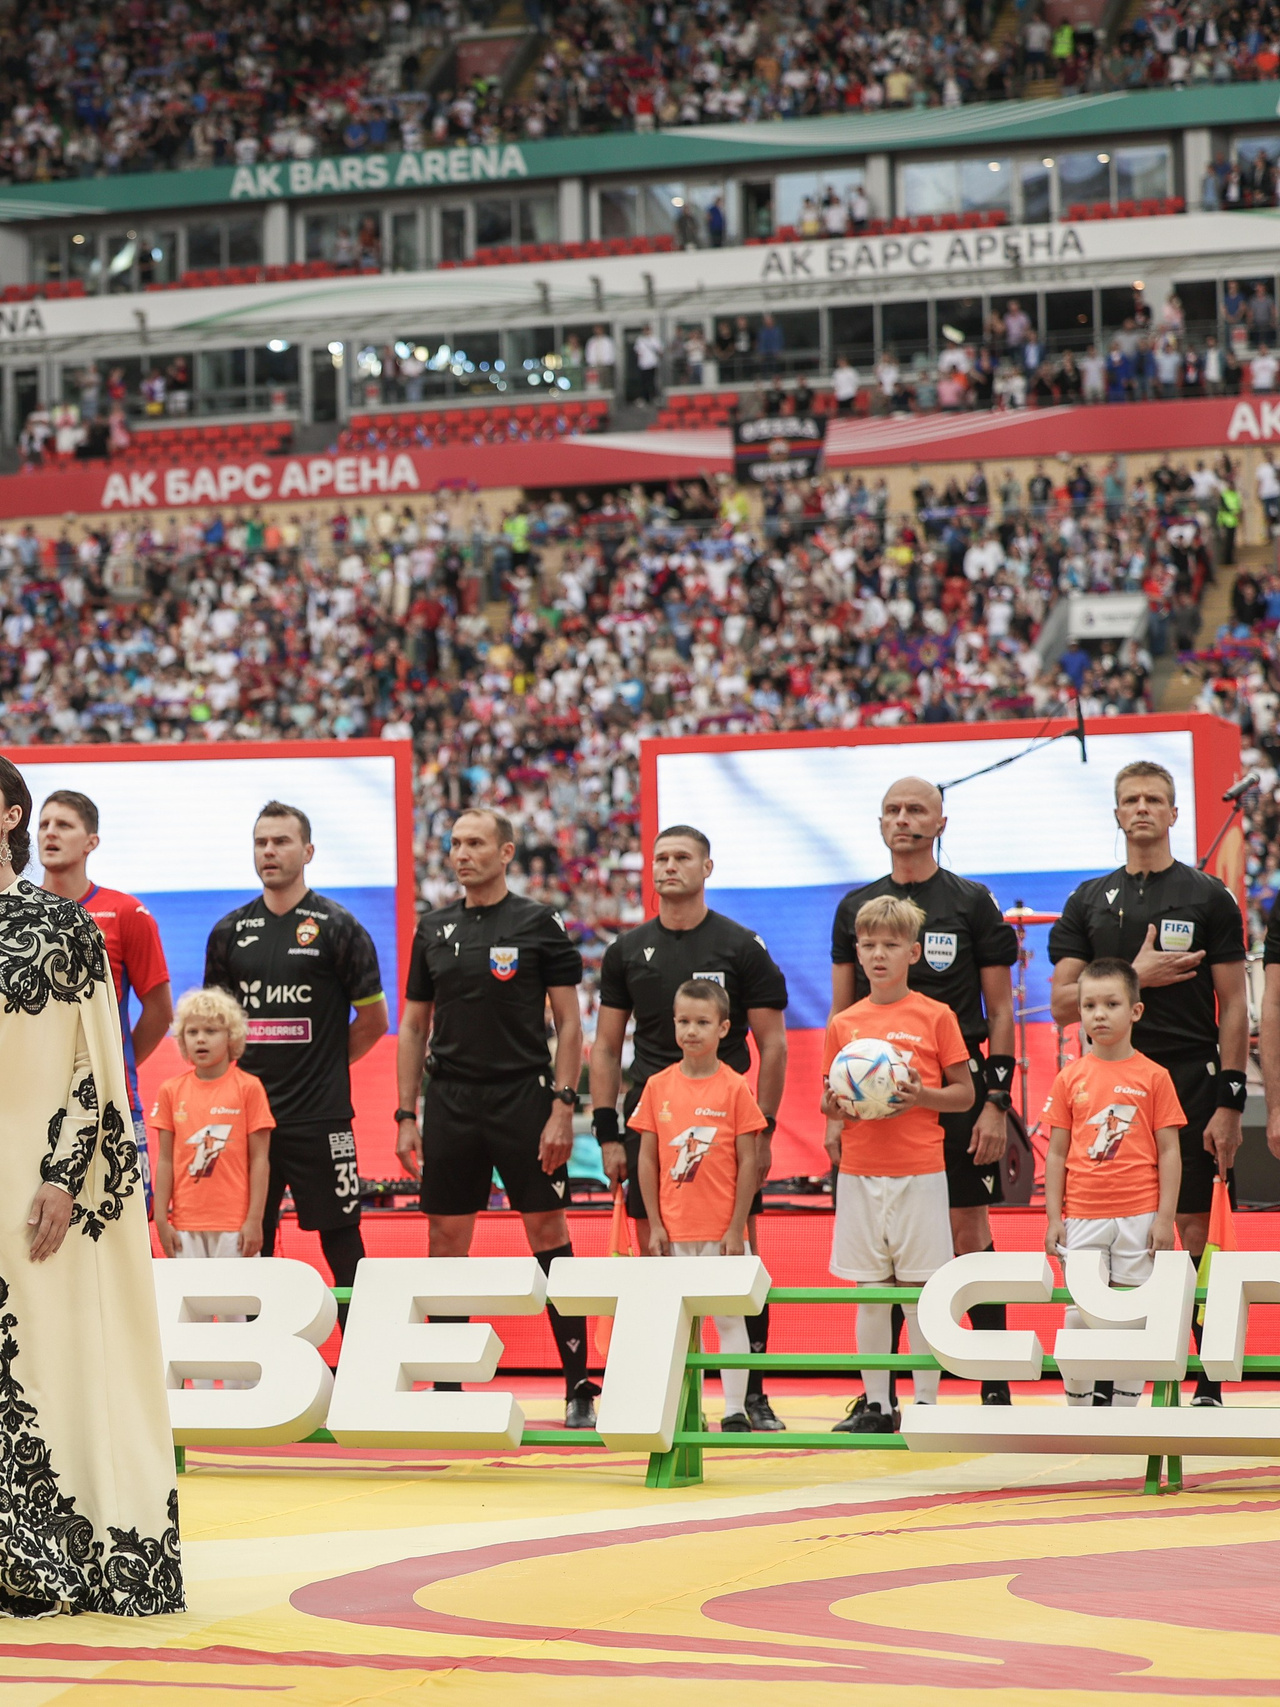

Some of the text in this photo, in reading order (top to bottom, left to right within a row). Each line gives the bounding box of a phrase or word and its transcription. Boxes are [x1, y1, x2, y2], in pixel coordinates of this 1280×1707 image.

[230, 143, 528, 199] AK BARS ARENA
[761, 228, 1085, 278] АК БАРС АРЕНА
[101, 453, 419, 509] АК БАРС АРЕНА
[928, 935, 953, 946] FIFA
[1164, 922, 1190, 934] FIFA
[266, 984, 313, 1004] ИКС
[334, 1161, 360, 1198] 35
